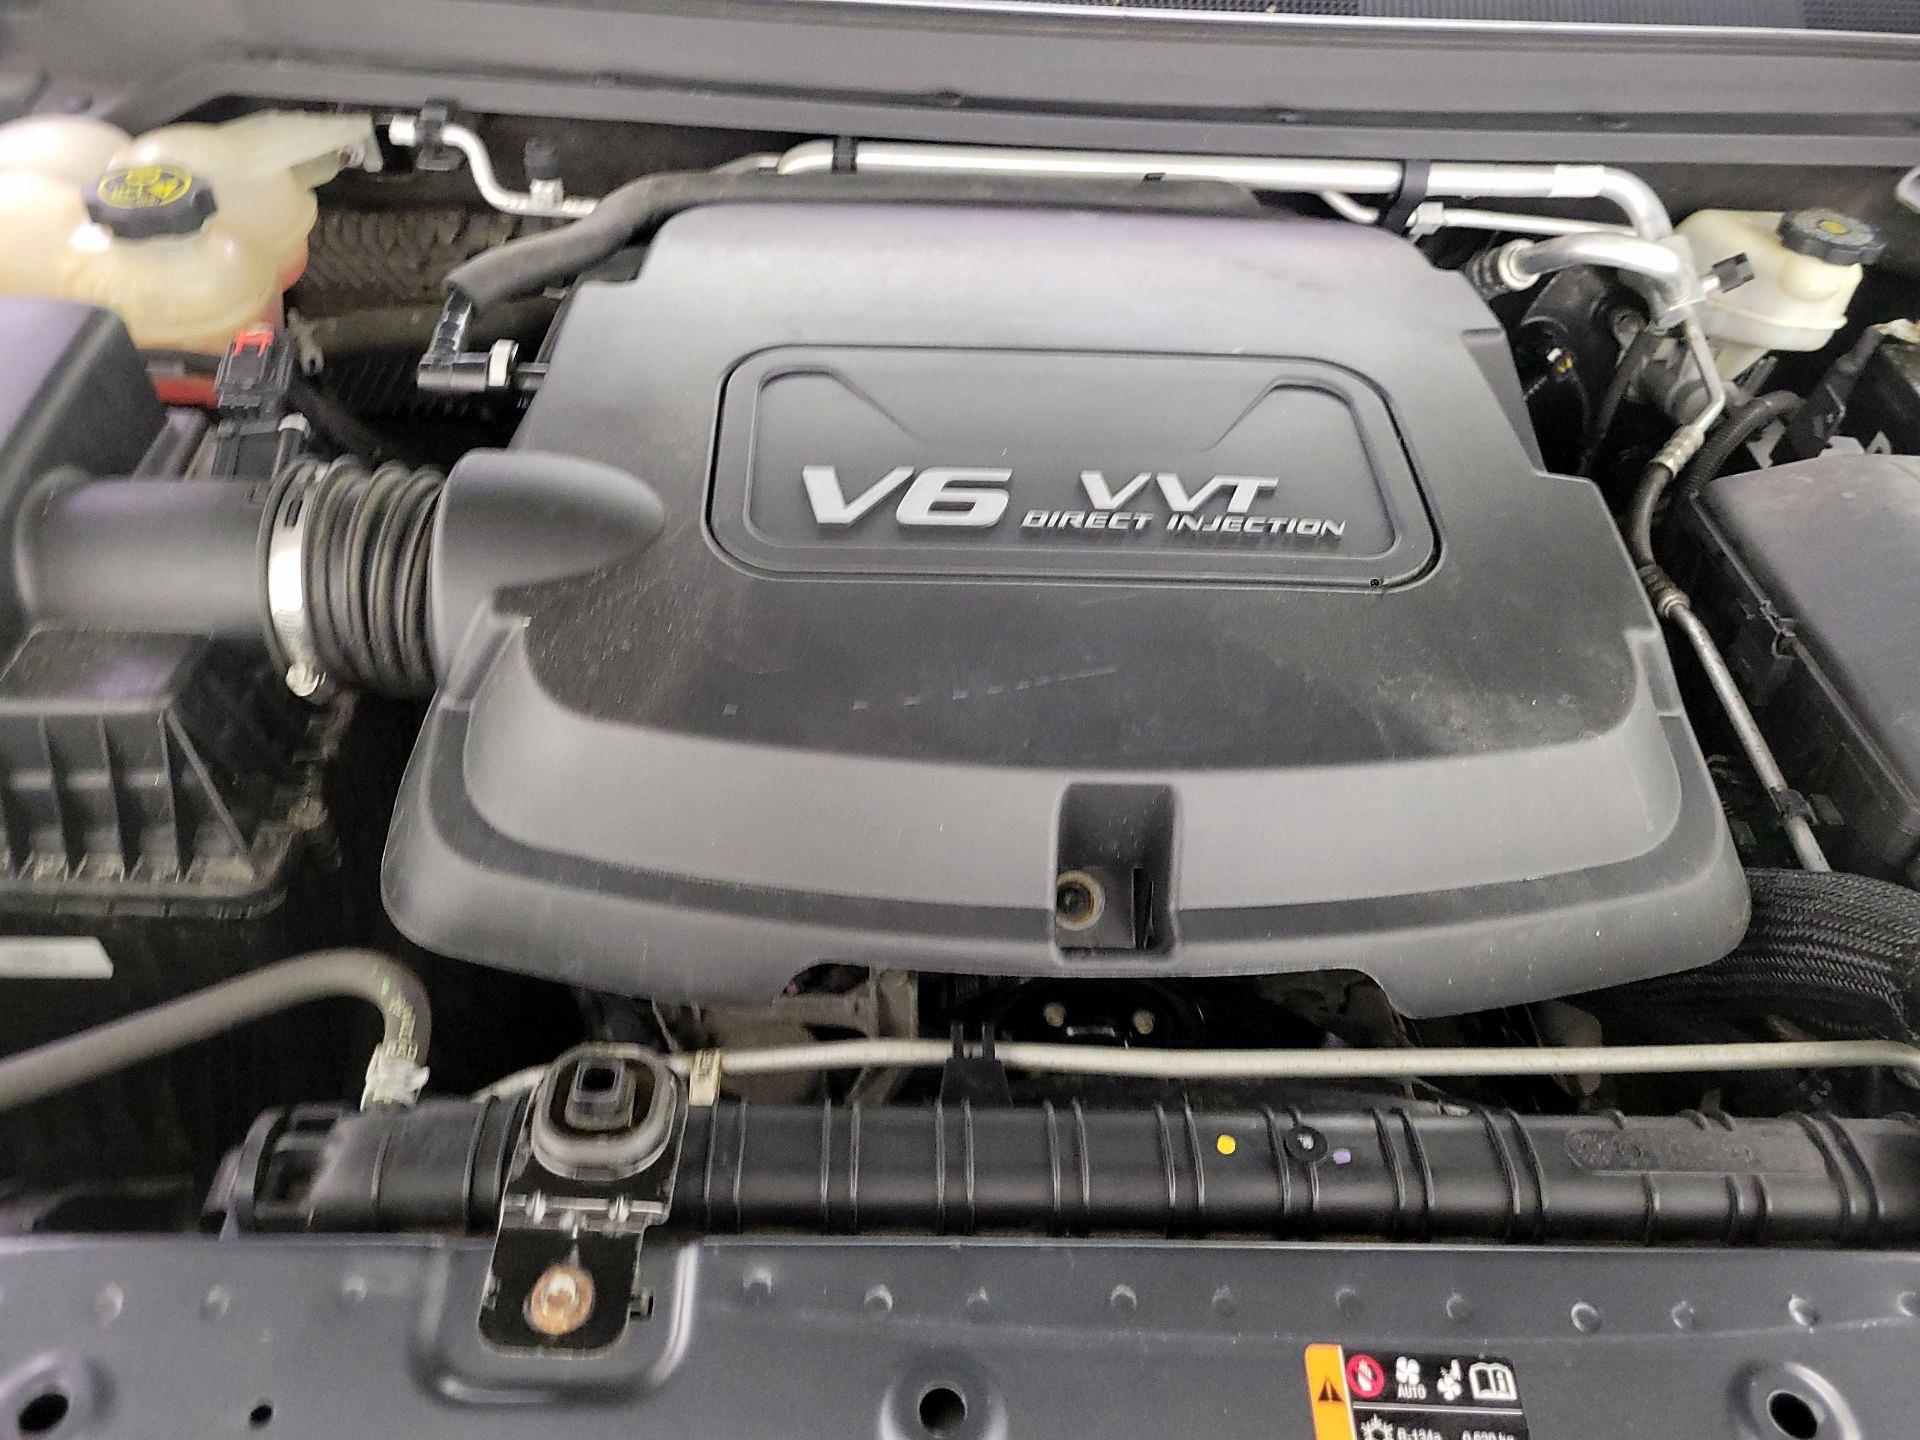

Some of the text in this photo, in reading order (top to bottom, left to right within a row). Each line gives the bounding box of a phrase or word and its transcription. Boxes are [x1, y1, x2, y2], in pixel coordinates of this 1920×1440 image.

[802, 466, 1279, 528] V6 VVT
[1020, 510, 1346, 538] DIRECT INJECTION
[1398, 1383, 1427, 1399] AUTO
